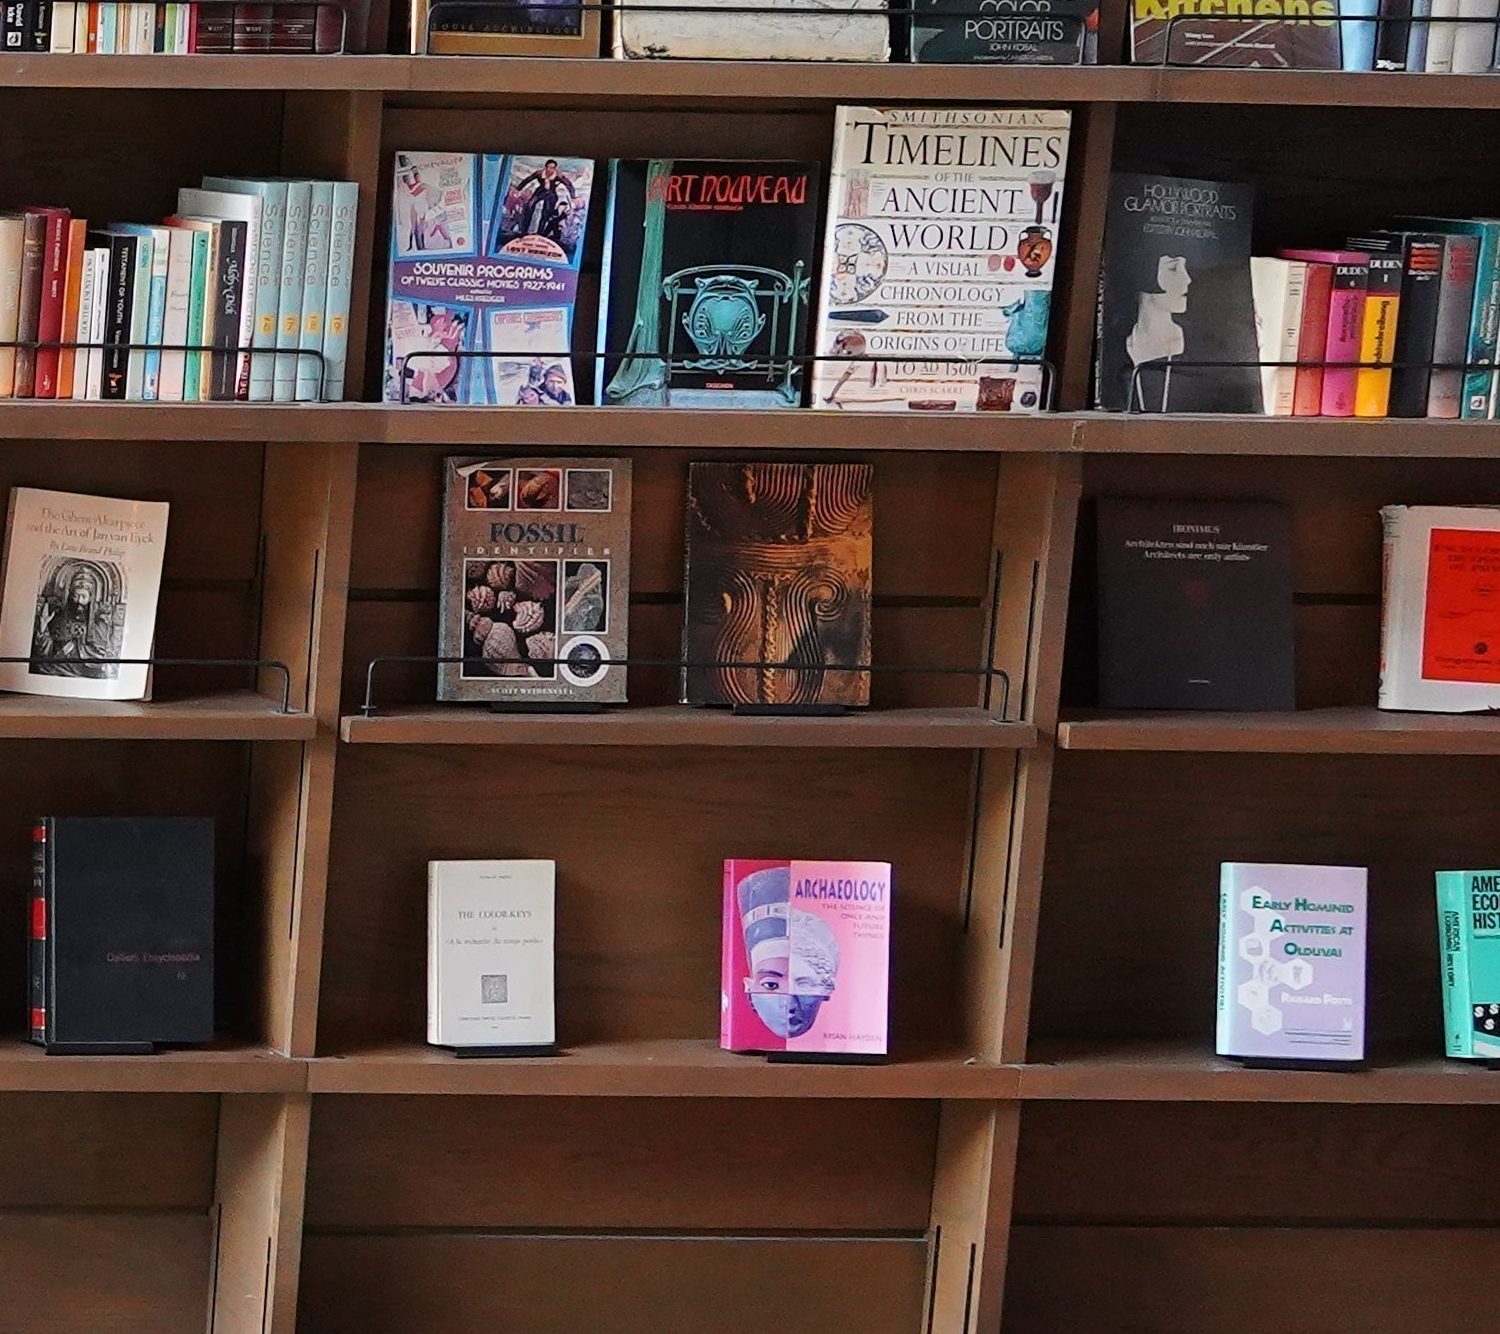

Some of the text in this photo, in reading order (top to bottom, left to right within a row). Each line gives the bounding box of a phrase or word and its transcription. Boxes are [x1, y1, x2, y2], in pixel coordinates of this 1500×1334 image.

[964, 19, 1064, 42] PORTRAITS
[888, 109, 1046, 126] SMITHSONIAN
[857, 120, 1062, 169] TIMELINES
[880, 185, 1022, 216] ANCIENT
[887, 223, 1009, 252] WORLD
[879, 284, 1006, 304] CHRONOLOGY
[488, 521, 584, 545] FOSSIL
[794, 878, 889, 902] ARCHAEOLOGY
